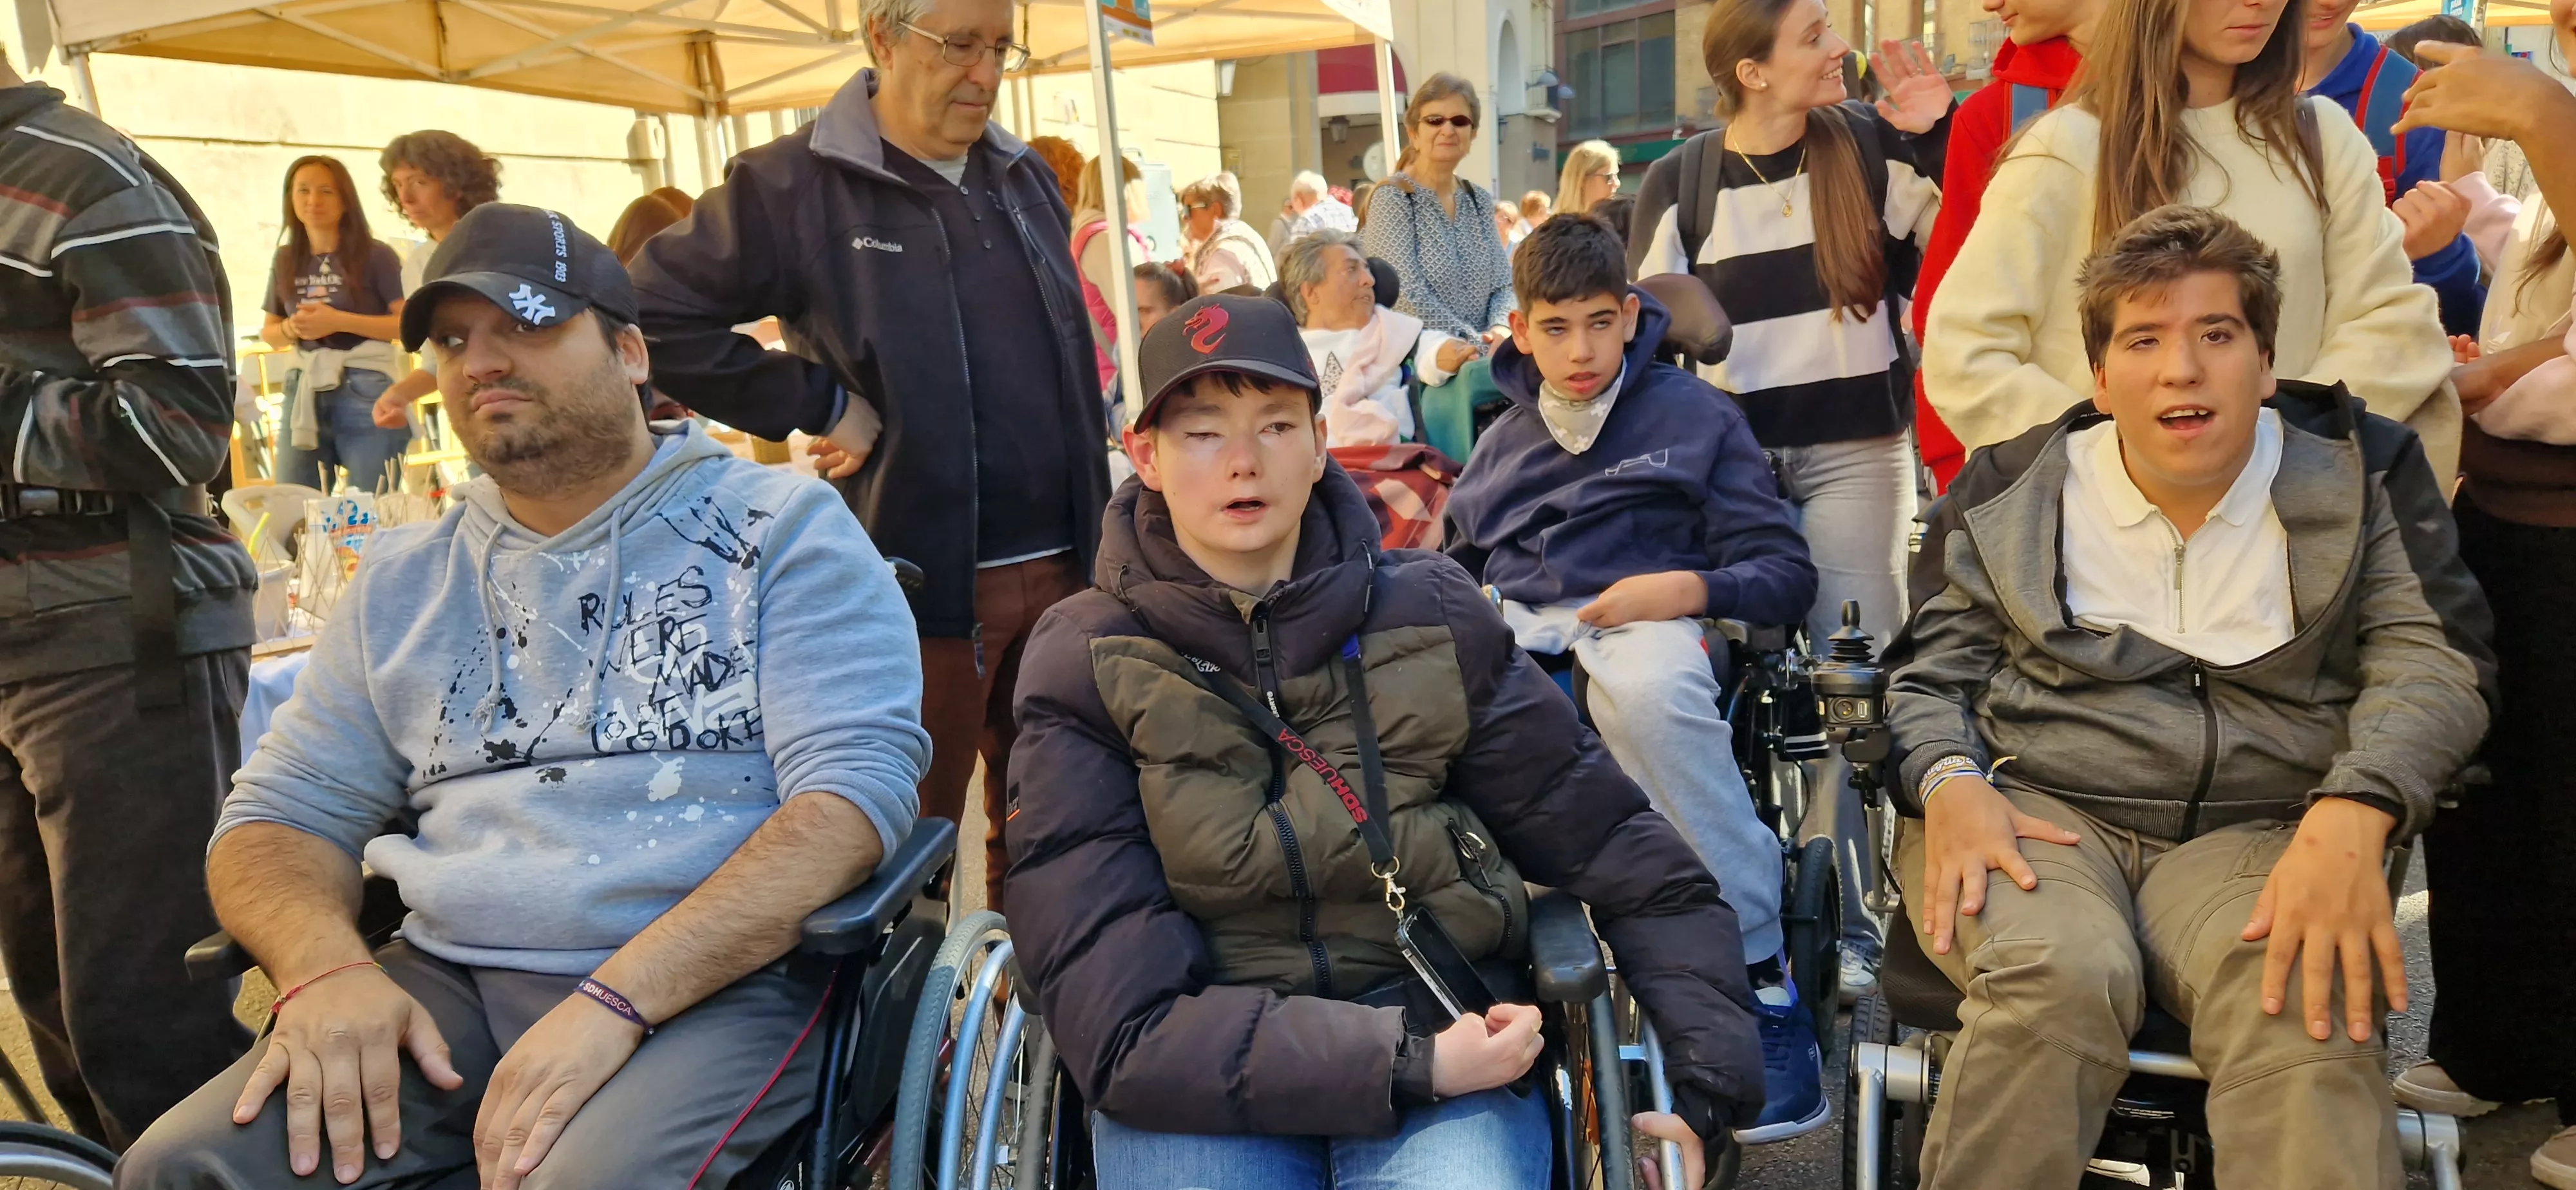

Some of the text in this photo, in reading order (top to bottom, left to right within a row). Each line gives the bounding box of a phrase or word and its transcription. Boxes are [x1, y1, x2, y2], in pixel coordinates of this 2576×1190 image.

[551, 220, 567, 258] SPORTS
[863, 236, 903, 252] Columbia
[554, 260, 567, 283] 1903
[578, 565, 713, 637] RULES
[1278, 728, 1368, 824] SDHUESCA
[583, 982, 632, 1015] SDHUESCA
